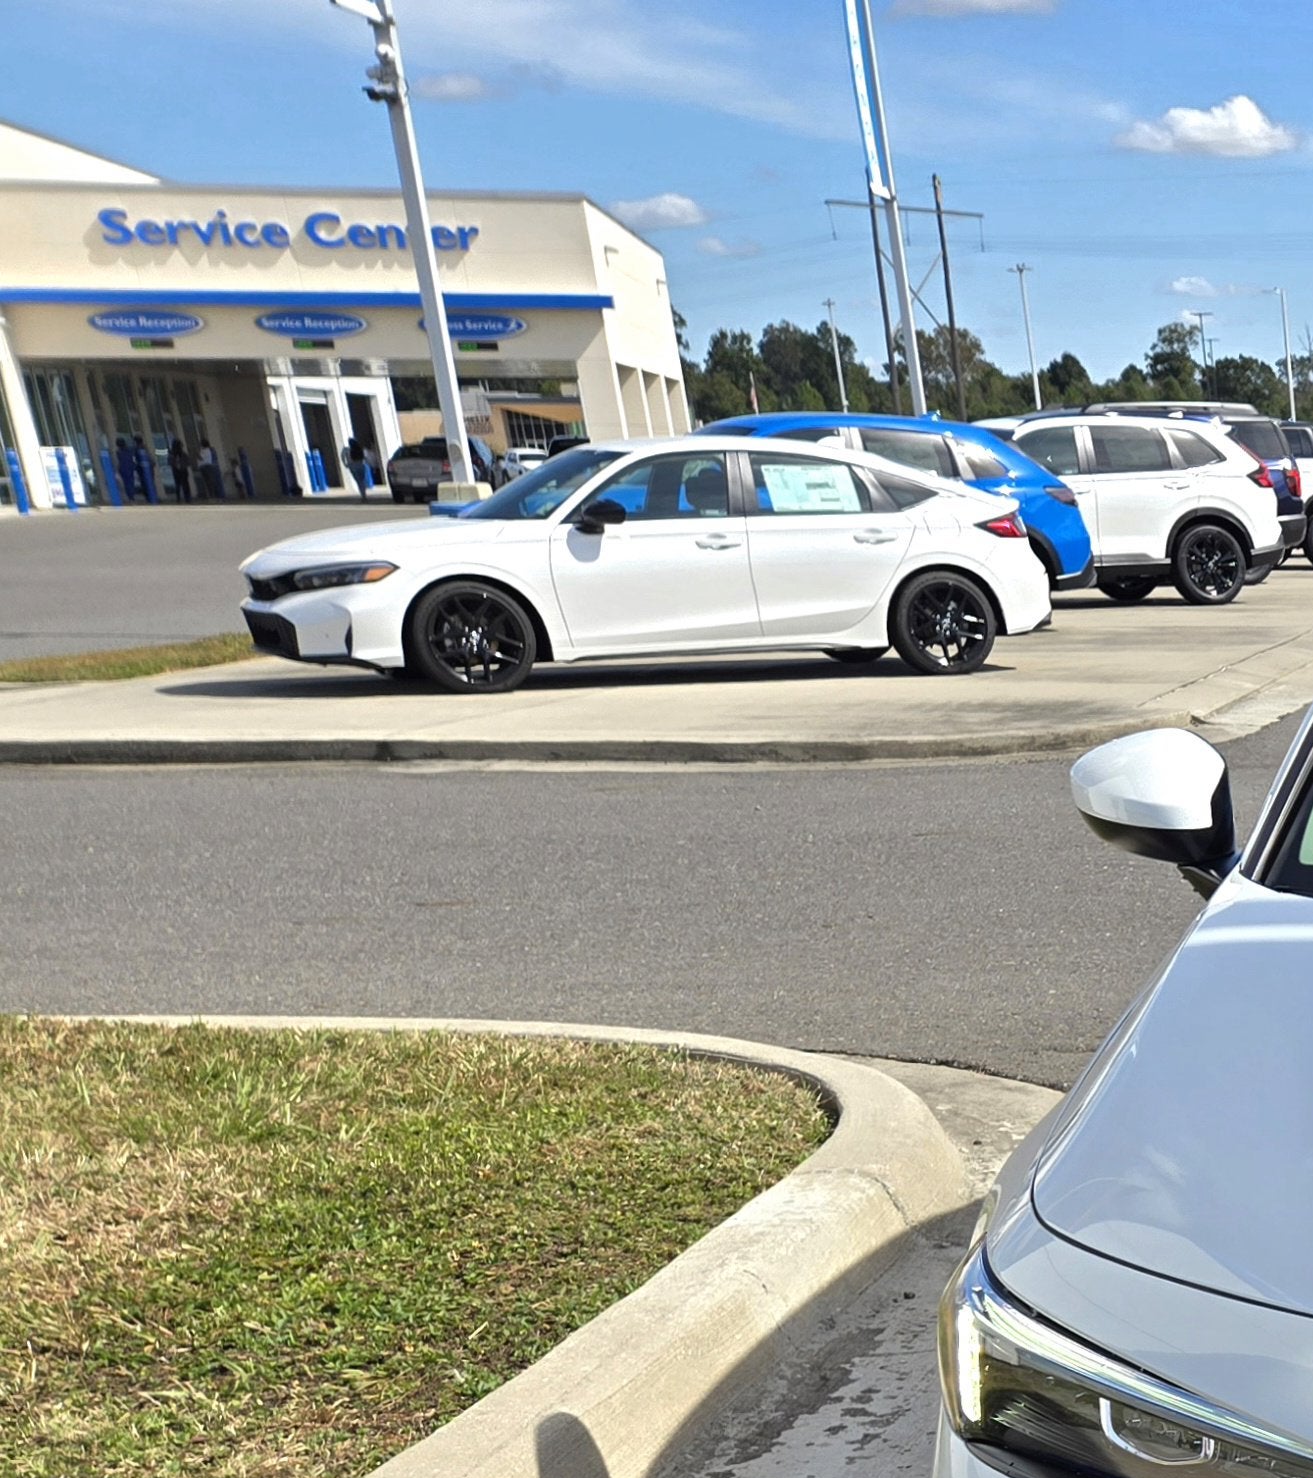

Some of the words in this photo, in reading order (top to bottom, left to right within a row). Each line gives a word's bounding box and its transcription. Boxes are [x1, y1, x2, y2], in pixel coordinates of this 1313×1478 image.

[98, 207, 290, 248] Service
[304, 212, 479, 249] Cener
[94, 315, 136, 328] Service
[138, 315, 197, 330] Reception
[260, 317, 302, 329] Service
[303, 316, 360, 331] Reception
[465, 319, 504, 331] Service
